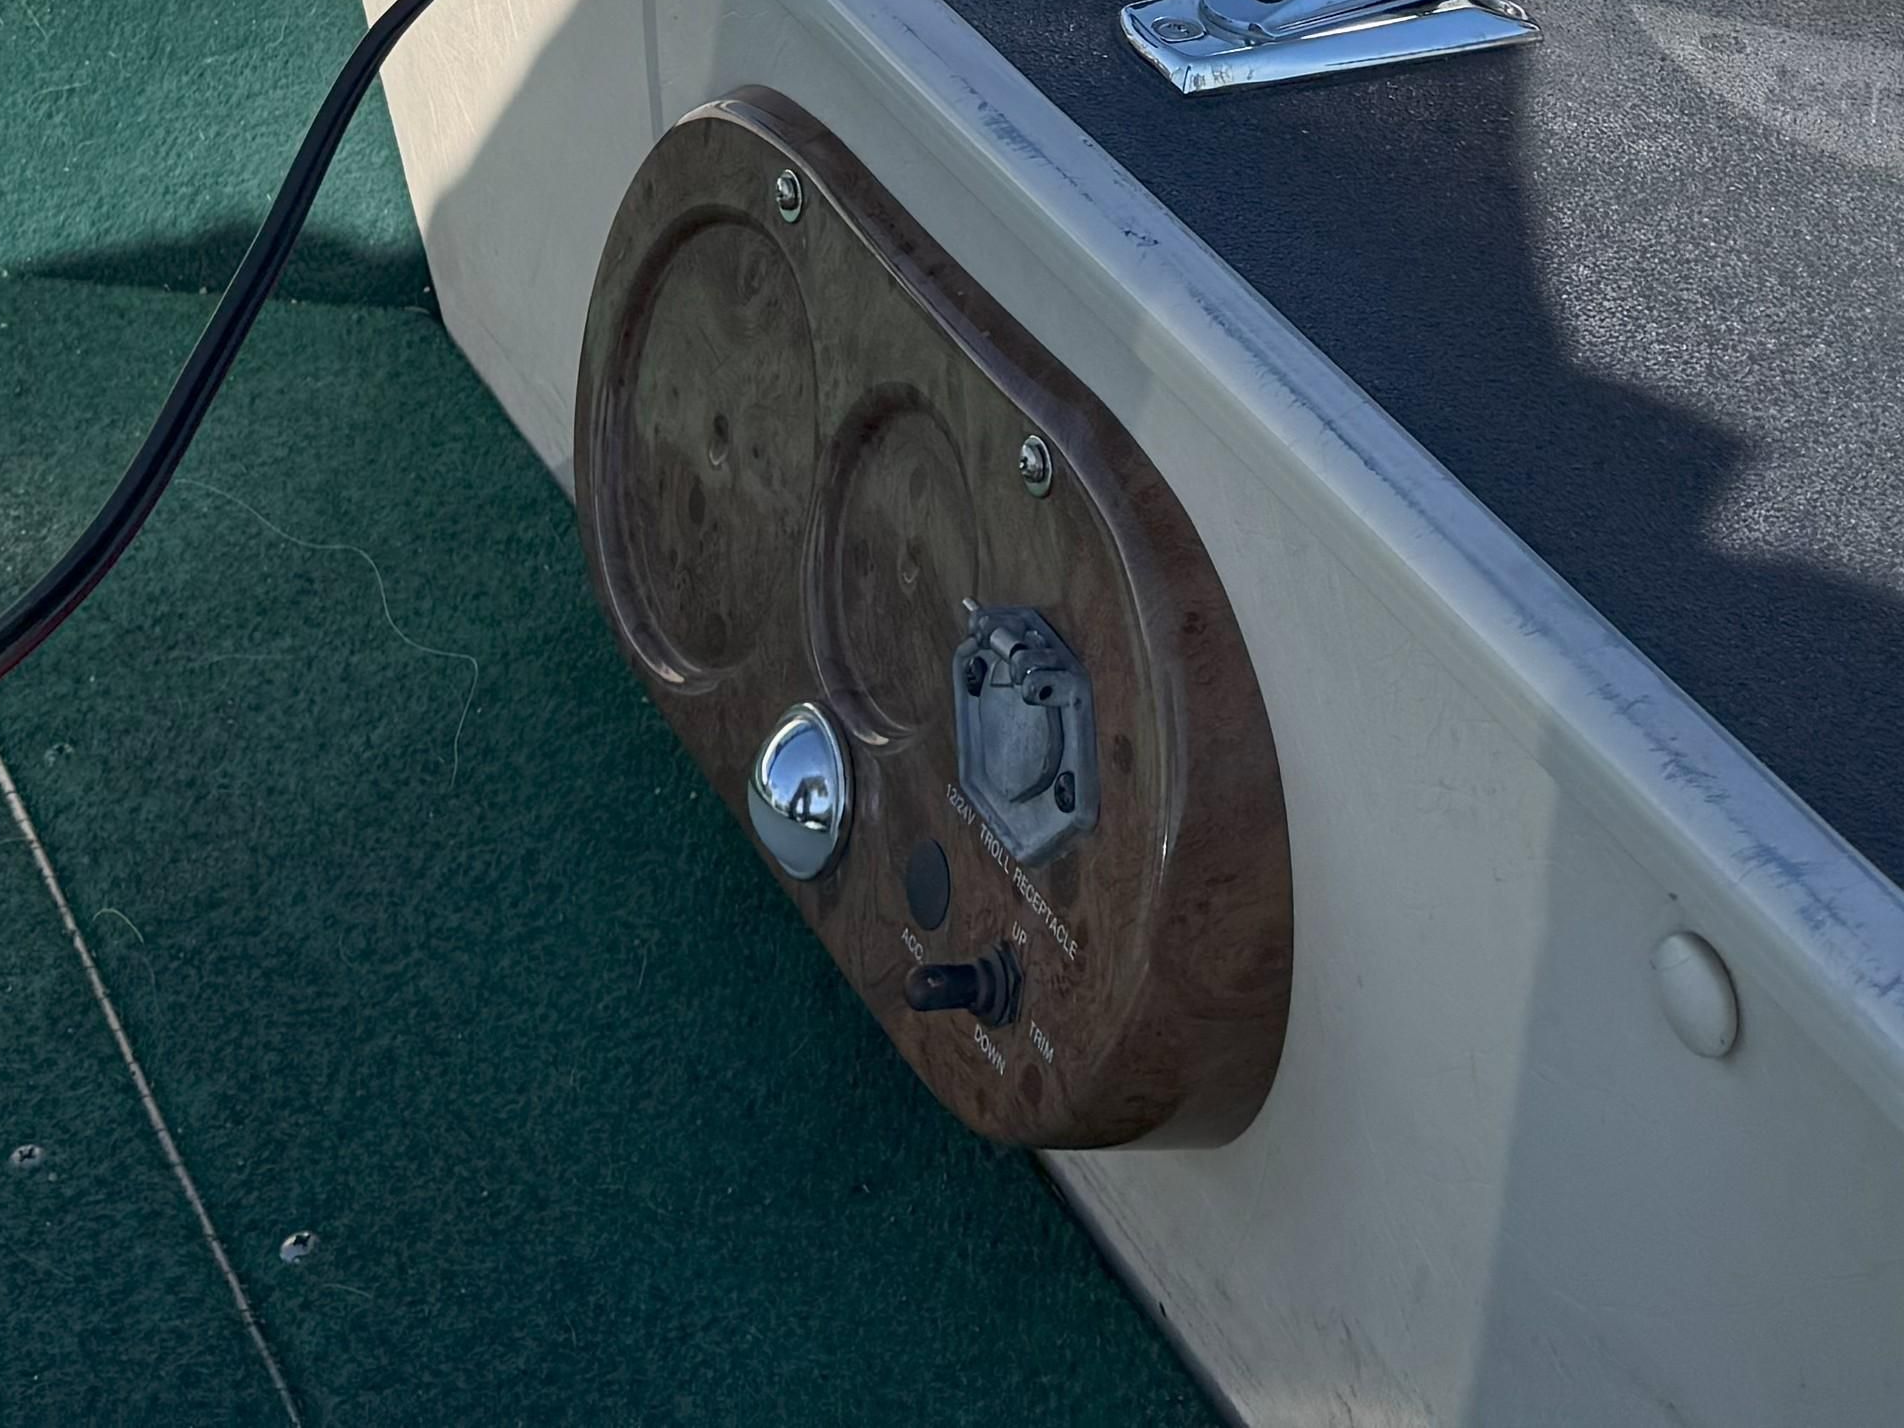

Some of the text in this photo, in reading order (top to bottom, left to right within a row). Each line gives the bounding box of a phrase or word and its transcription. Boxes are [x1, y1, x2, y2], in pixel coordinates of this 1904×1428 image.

[946, 783, 1079, 961] 12/24V TROLL RECEPTACLE
[1012, 920, 1028, 946] UP
[974, 1023, 1006, 1077] DOWN
[1029, 1019, 1054, 1064] TRIM
